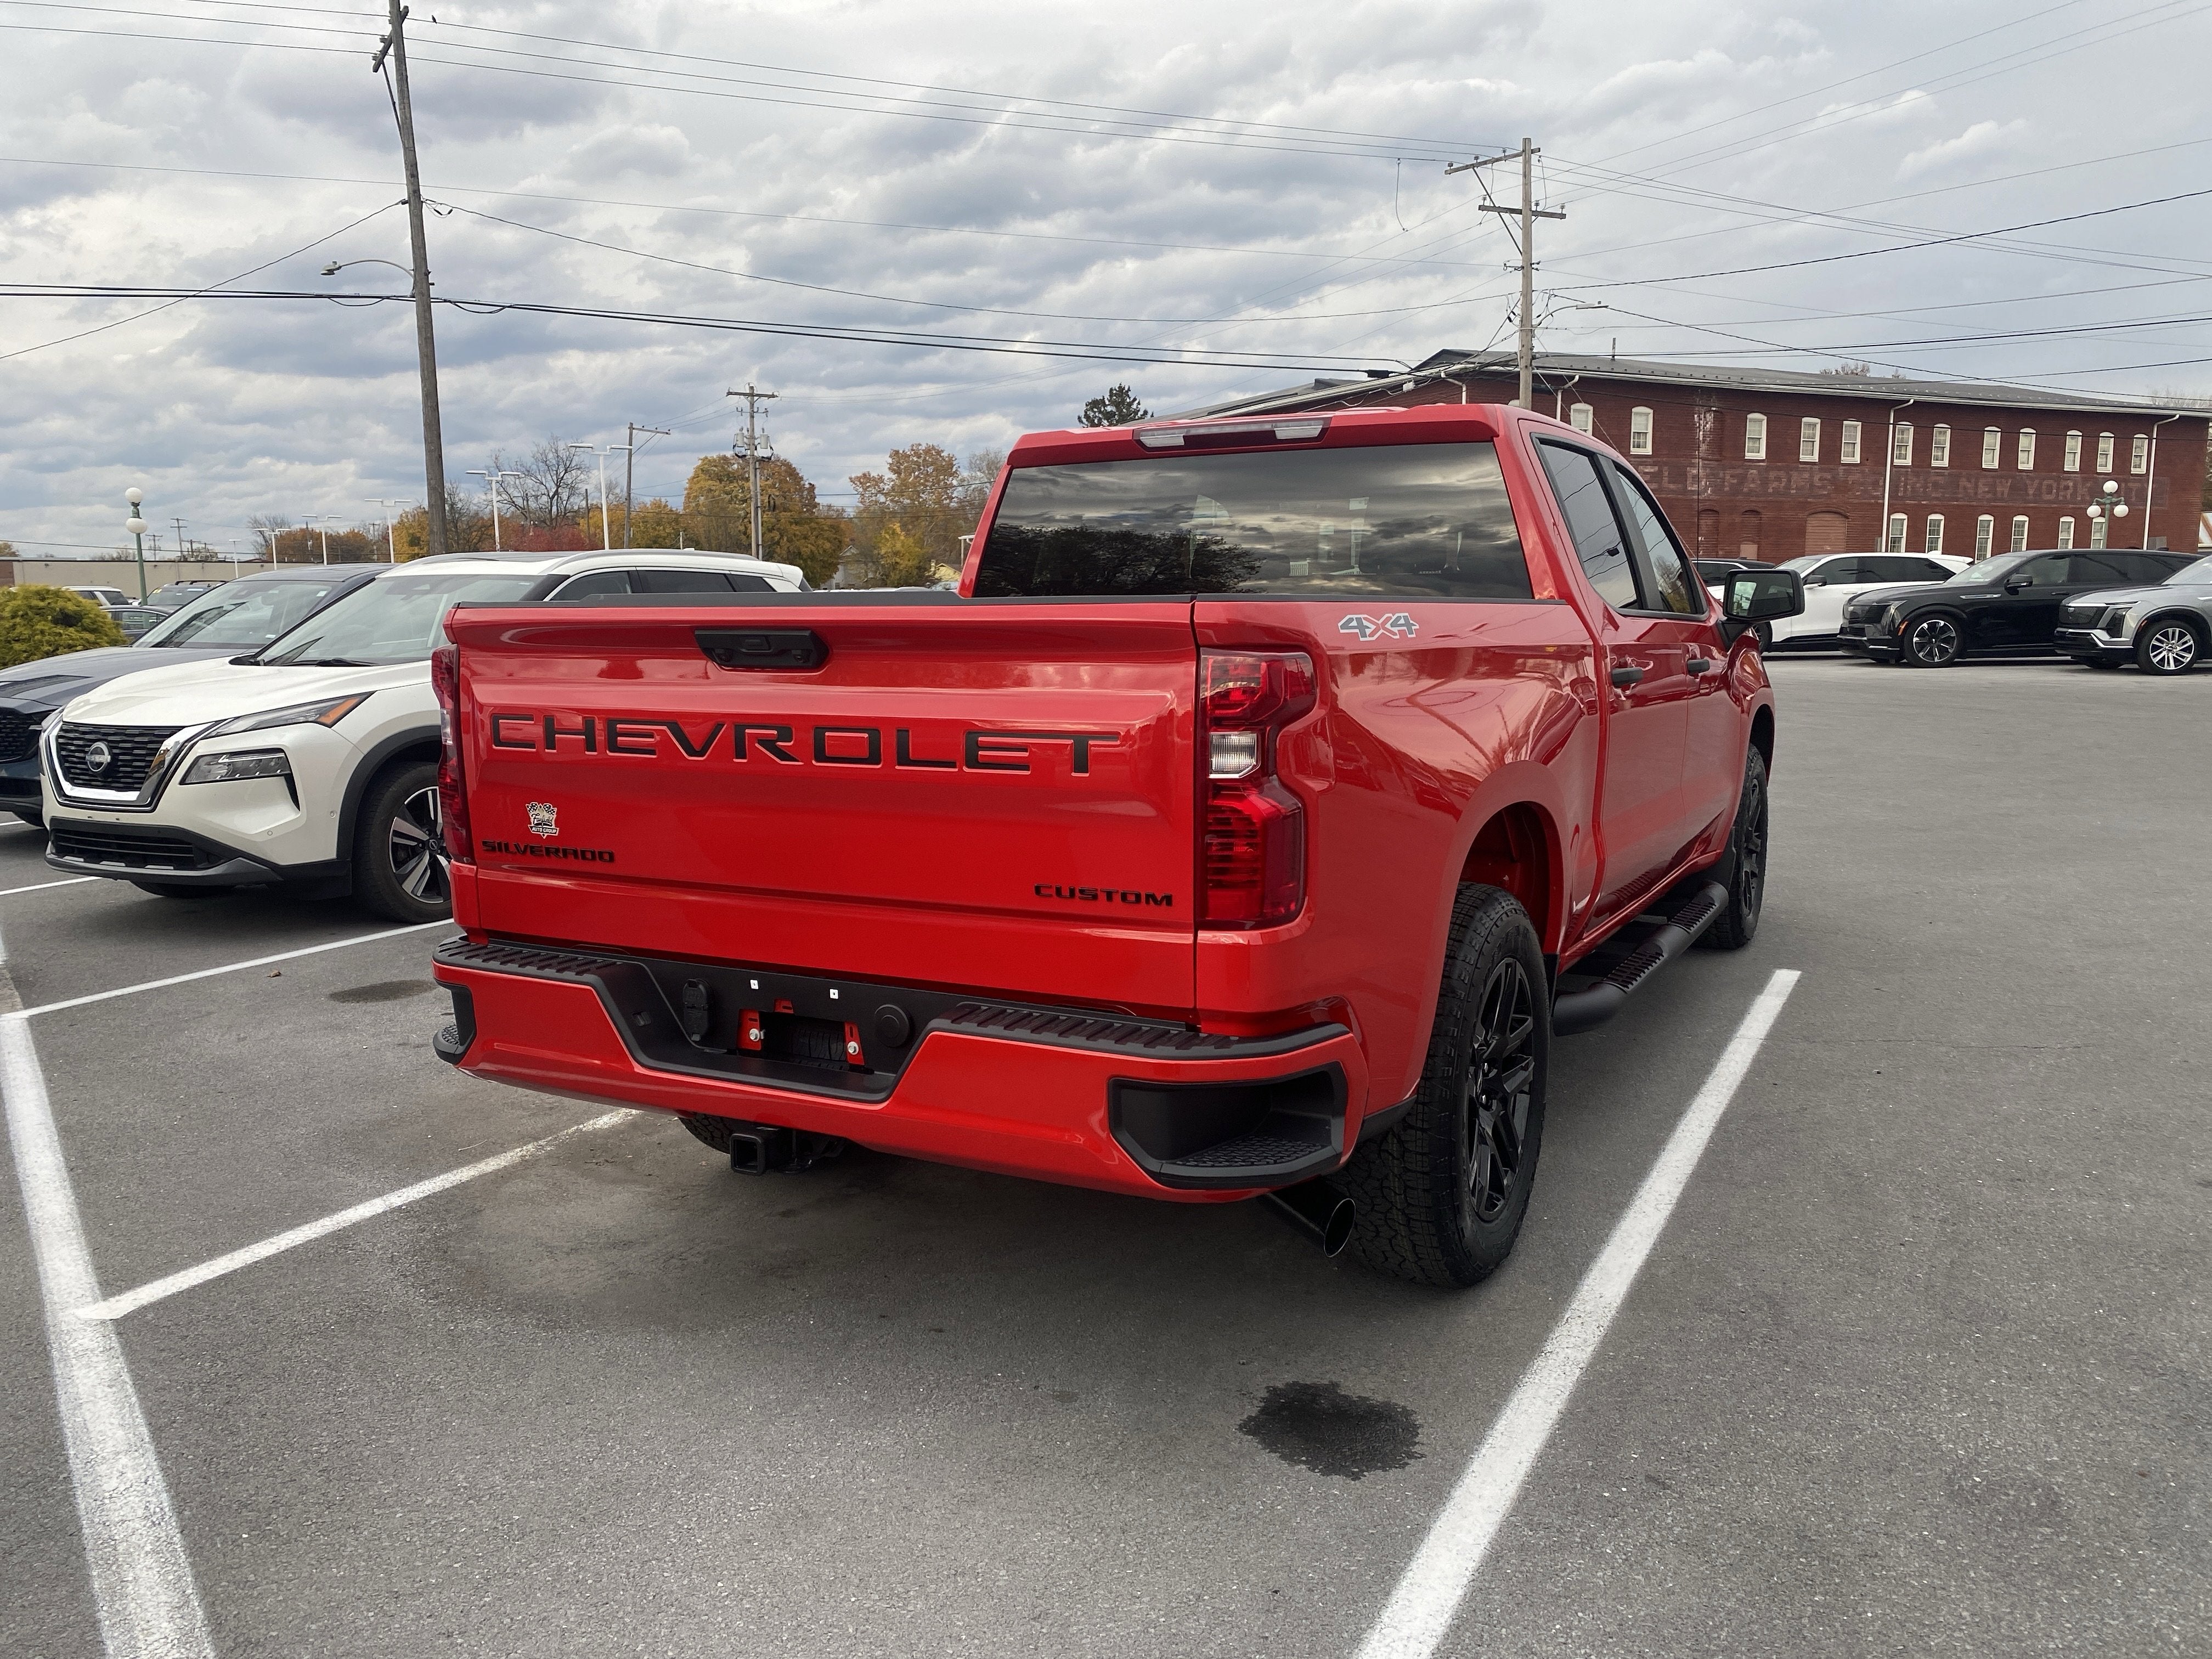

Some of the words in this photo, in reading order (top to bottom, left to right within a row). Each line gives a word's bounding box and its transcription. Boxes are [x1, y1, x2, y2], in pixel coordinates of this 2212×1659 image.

[1958, 477, 2012, 498] NEW
[2026, 479, 2092, 500] YORK
[493, 714, 1121, 777] CHEVROLET
[86, 754, 111, 763] NISSAN
[482, 839, 615, 863] SILVERADO
[1034, 883, 1173, 907] CUSTOM
